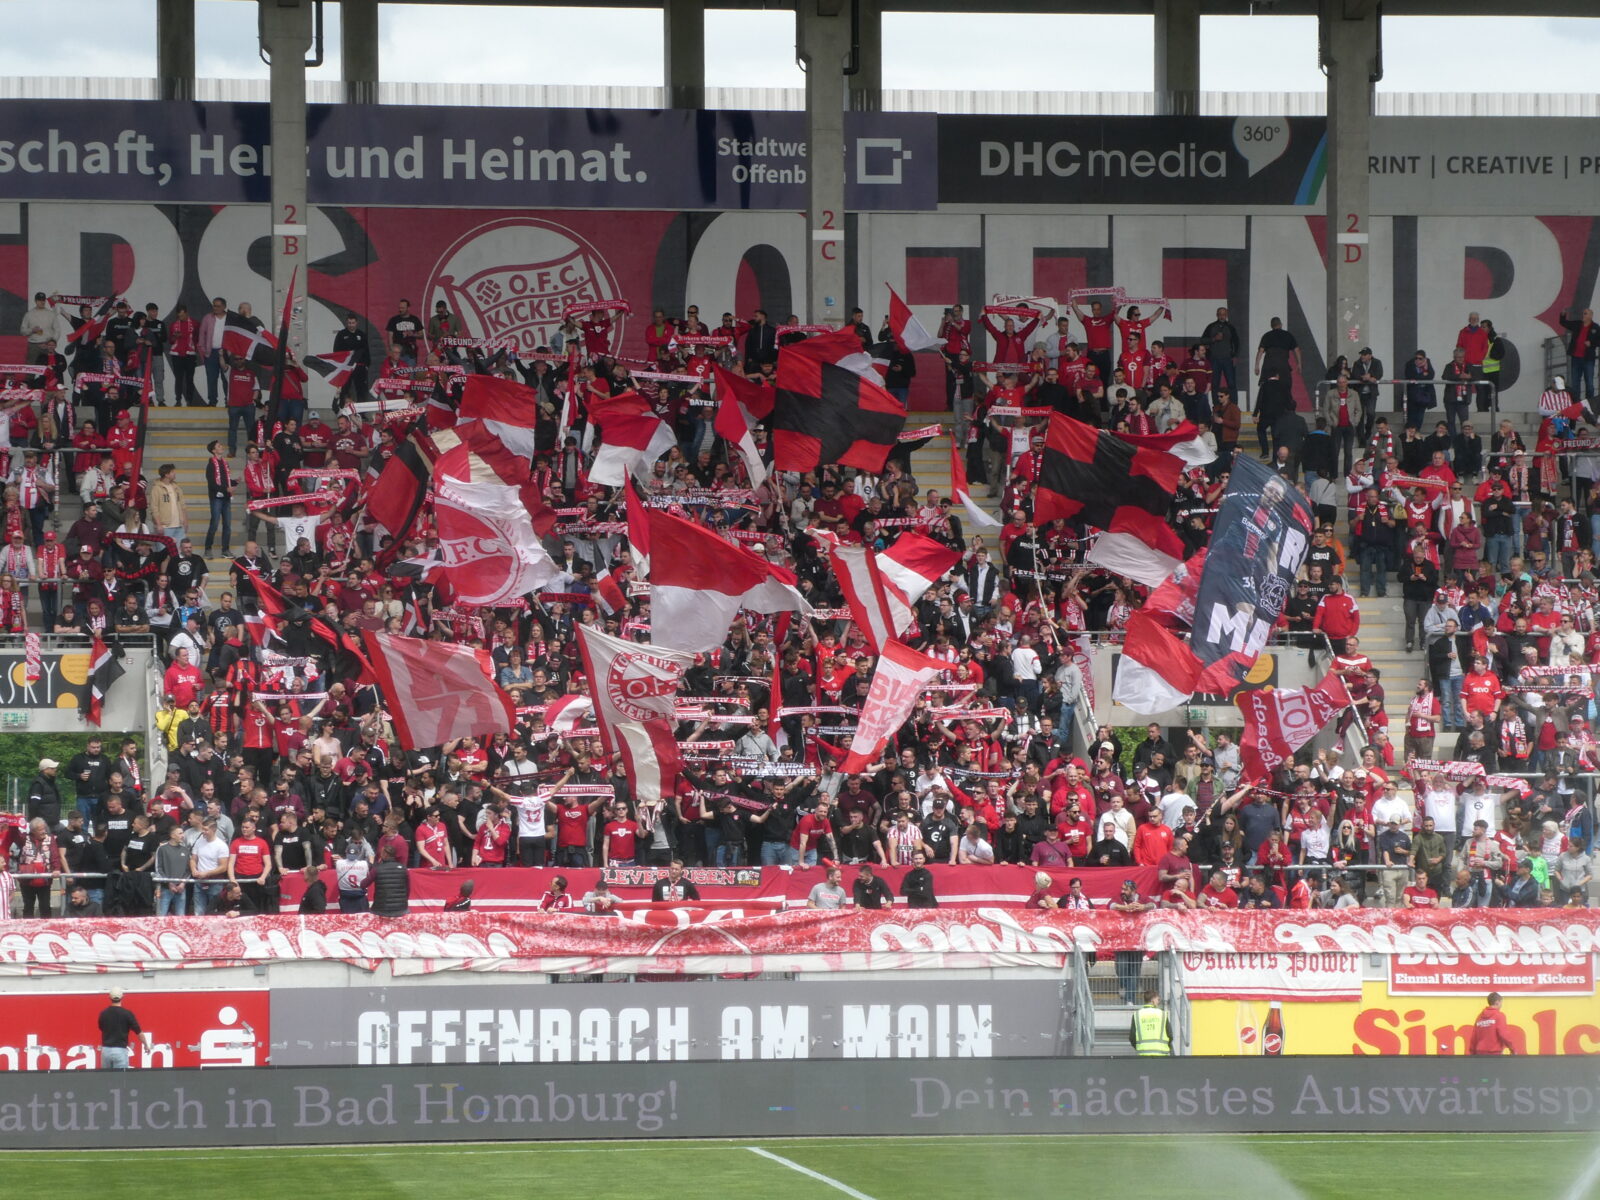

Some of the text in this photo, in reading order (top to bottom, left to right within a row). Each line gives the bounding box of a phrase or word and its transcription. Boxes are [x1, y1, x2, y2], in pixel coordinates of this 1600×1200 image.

[1243, 126, 1281, 142] 360°
[0, 128, 647, 186] schaft, Her und Heimat.
[1446, 155, 1553, 175] CREATIVE
[285, 205, 297, 224] 2
[823, 210, 835, 230] 2
[1346, 214, 1360, 233] 2
[283, 237, 299, 255] B
[821, 241, 836, 261] C
[1344, 244, 1362, 263] D
[508, 265, 585, 295] O.F.C.
[486, 285, 595, 333] KICKERS
[1543, 667, 1583, 675] KICKERS
[1395, 973, 1586, 984] Einmal Kickers immer Kickers
[721, 1005, 809, 1059] AM
[842, 1004, 993, 1059] MAIN
[0, 1080, 678, 1132] atürlich in Bad Homburg!
[909, 1076, 1032, 1119] Dein
[1049, 1074, 1275, 1118] nächstes
